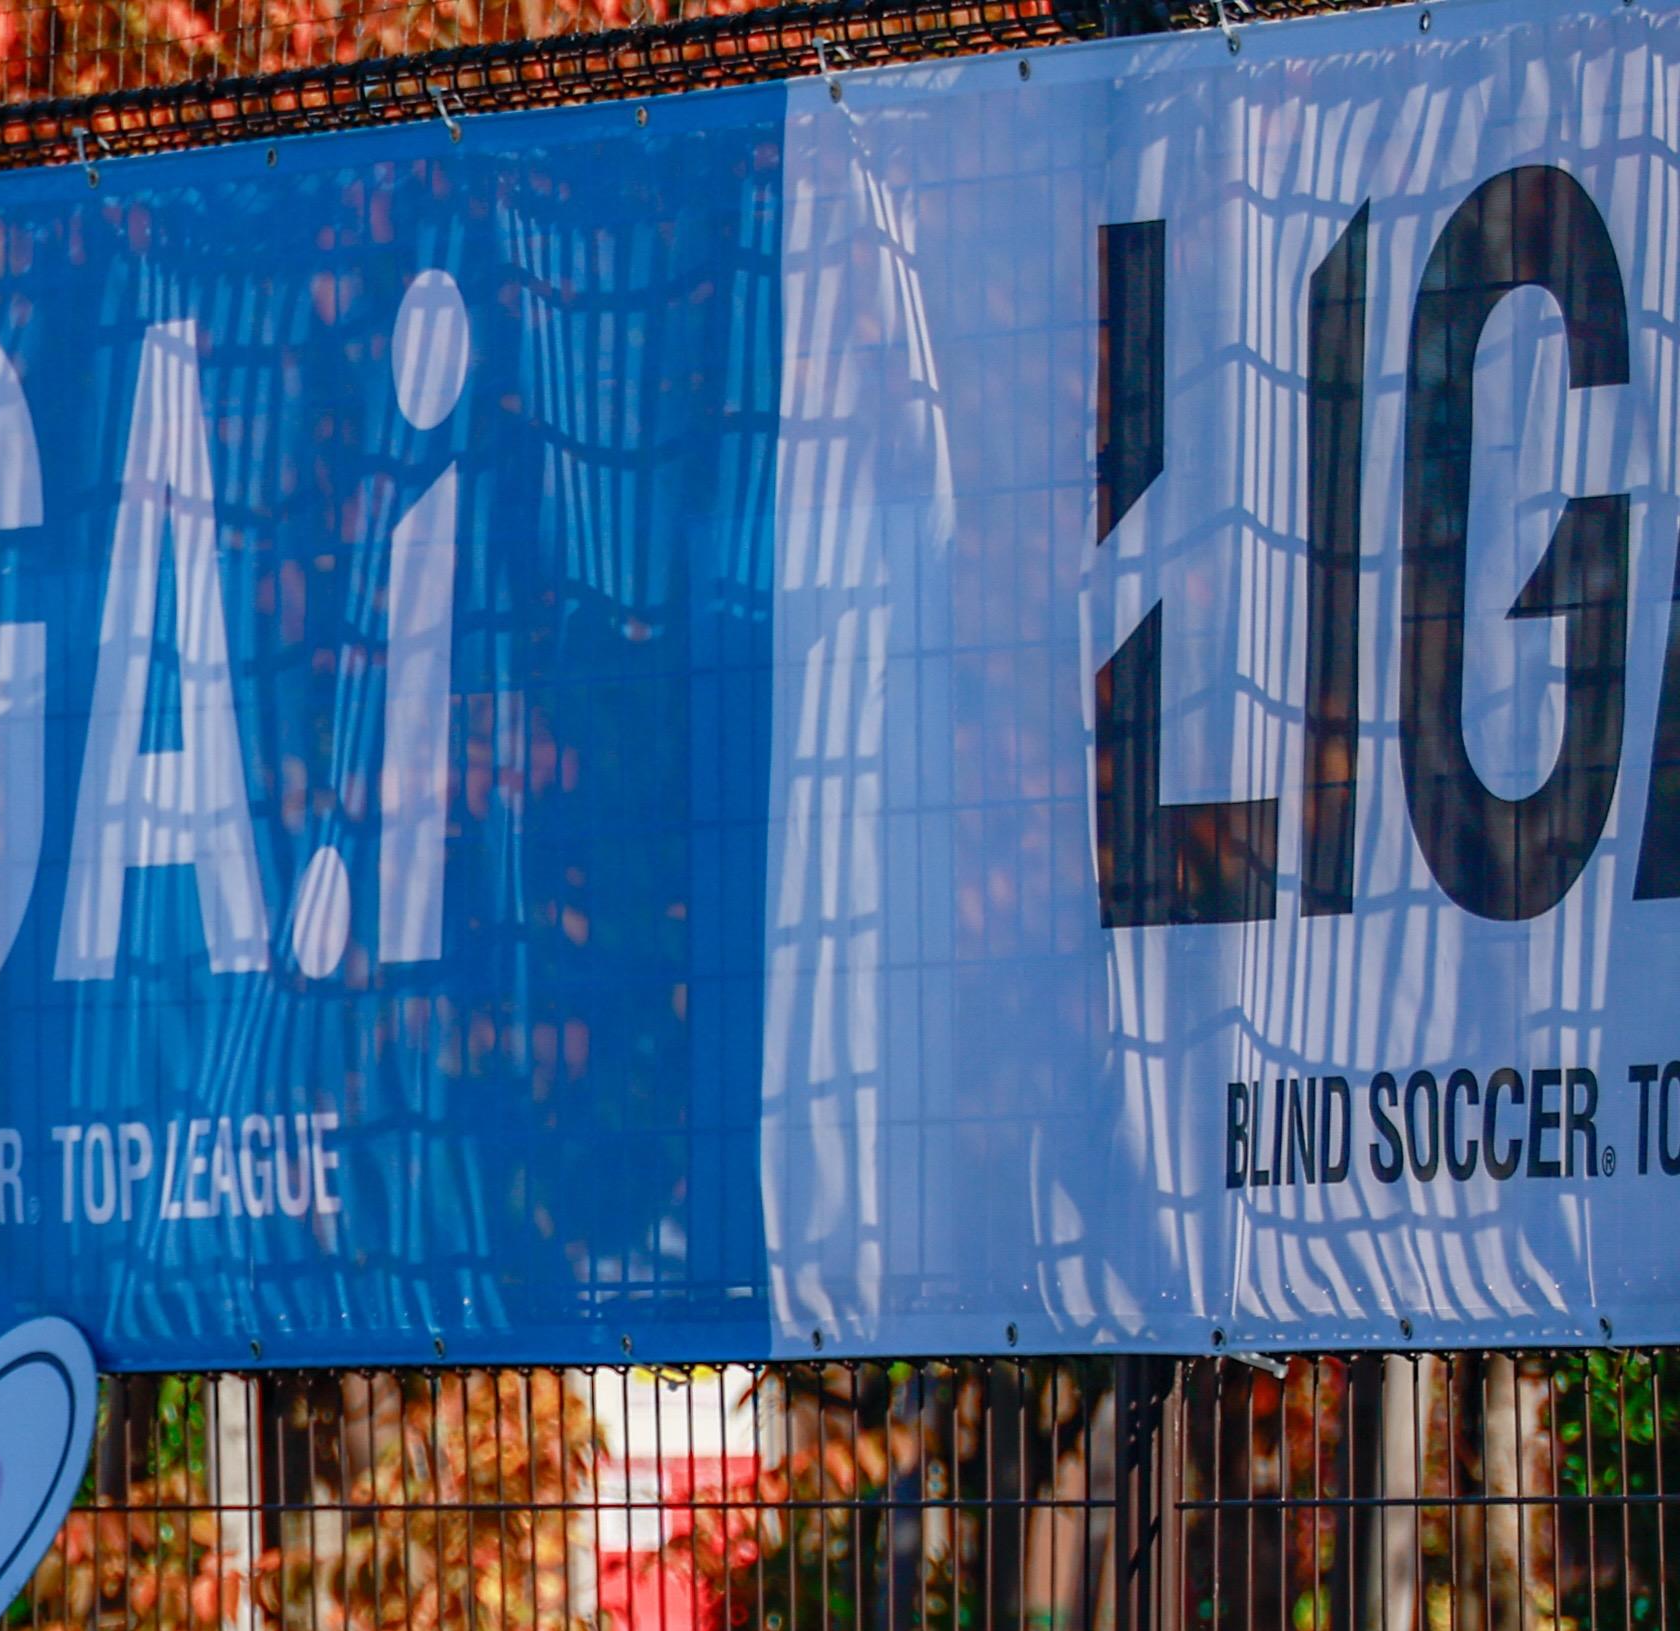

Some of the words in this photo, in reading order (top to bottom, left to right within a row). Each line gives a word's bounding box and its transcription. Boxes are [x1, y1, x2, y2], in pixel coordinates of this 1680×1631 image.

[51, 1121, 154, 1225] TOP
[159, 1112, 342, 1219] LEAGUE
[1226, 1075, 1351, 1189] BLIND
